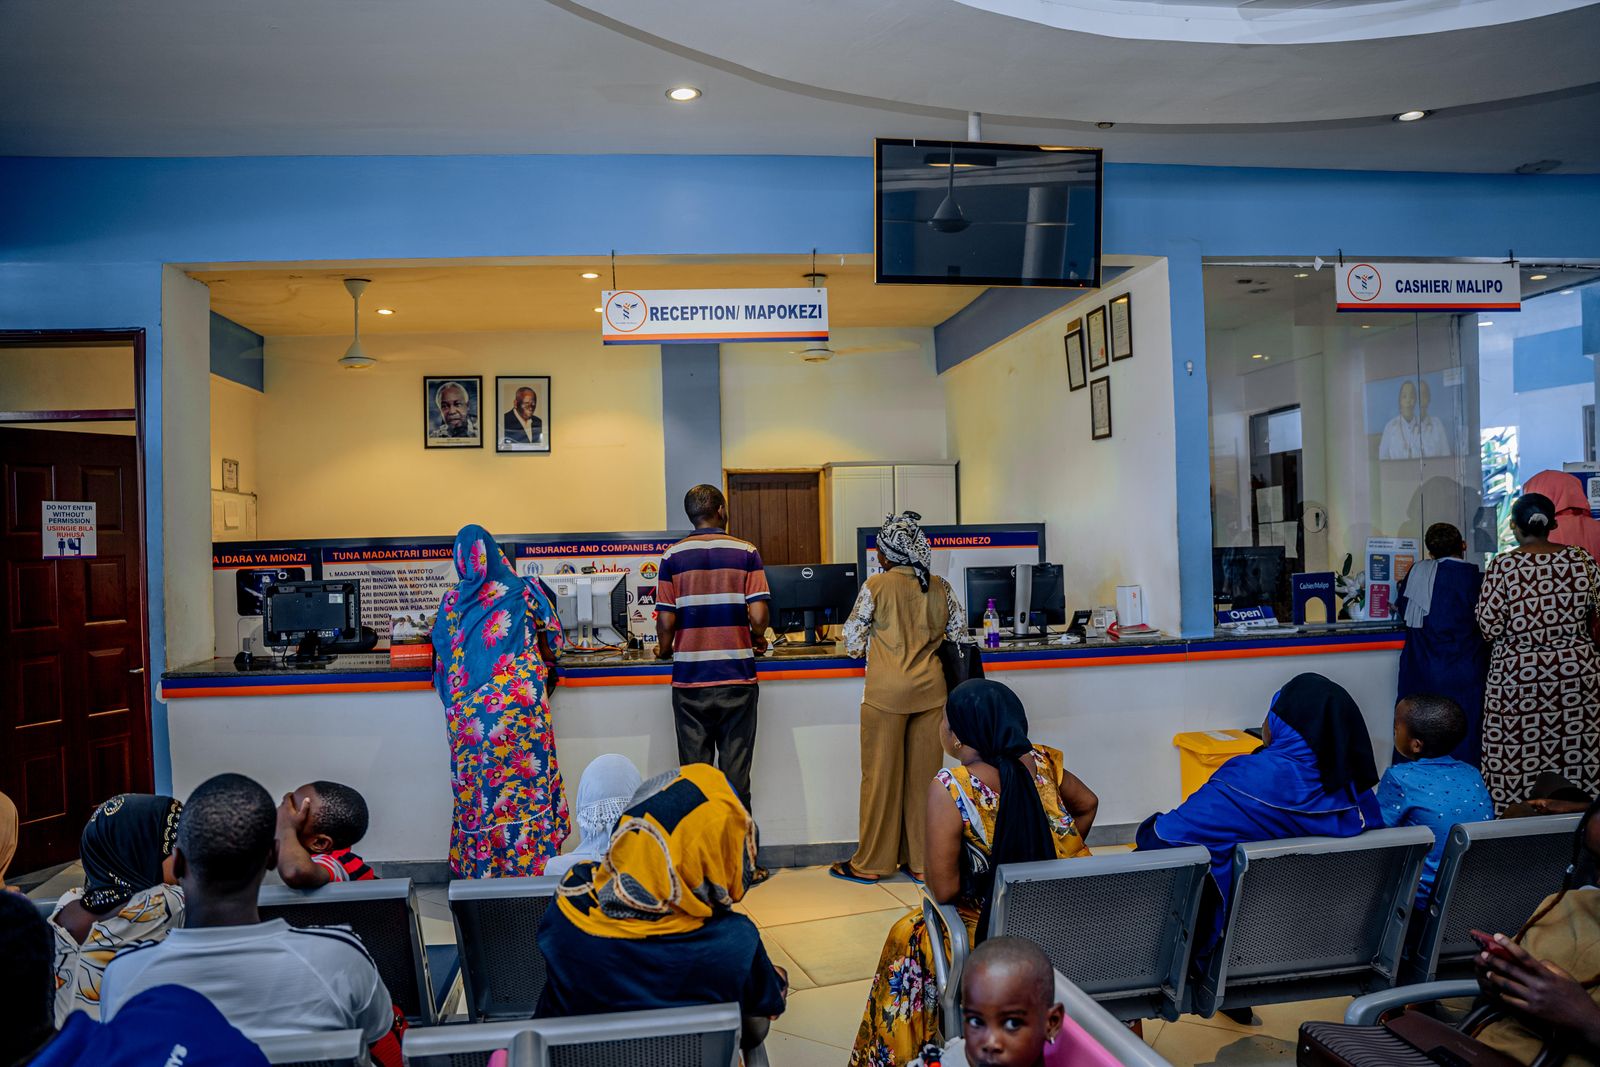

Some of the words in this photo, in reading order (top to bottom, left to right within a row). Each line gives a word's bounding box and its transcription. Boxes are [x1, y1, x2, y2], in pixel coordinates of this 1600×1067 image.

[1395, 279, 1453, 294] CASHIER/
[1456, 279, 1503, 293] MALIPO
[649, 304, 740, 322] RECEPTION/
[744, 304, 823, 320] MAPOKEZI
[933, 536, 991, 545] NYINGINEZO
[526, 545, 578, 554] INSURANCE
[579, 544, 599, 553] AND
[600, 543, 655, 552] COMPANIES
[221, 554, 253, 564] IDARA
[255, 554, 268, 563] YA
[269, 553, 307, 562] MIONZI
[332, 551, 360, 560] TUNA
[362, 549, 420, 559] MADAKTARI
[1230, 608, 1261, 620] Open
